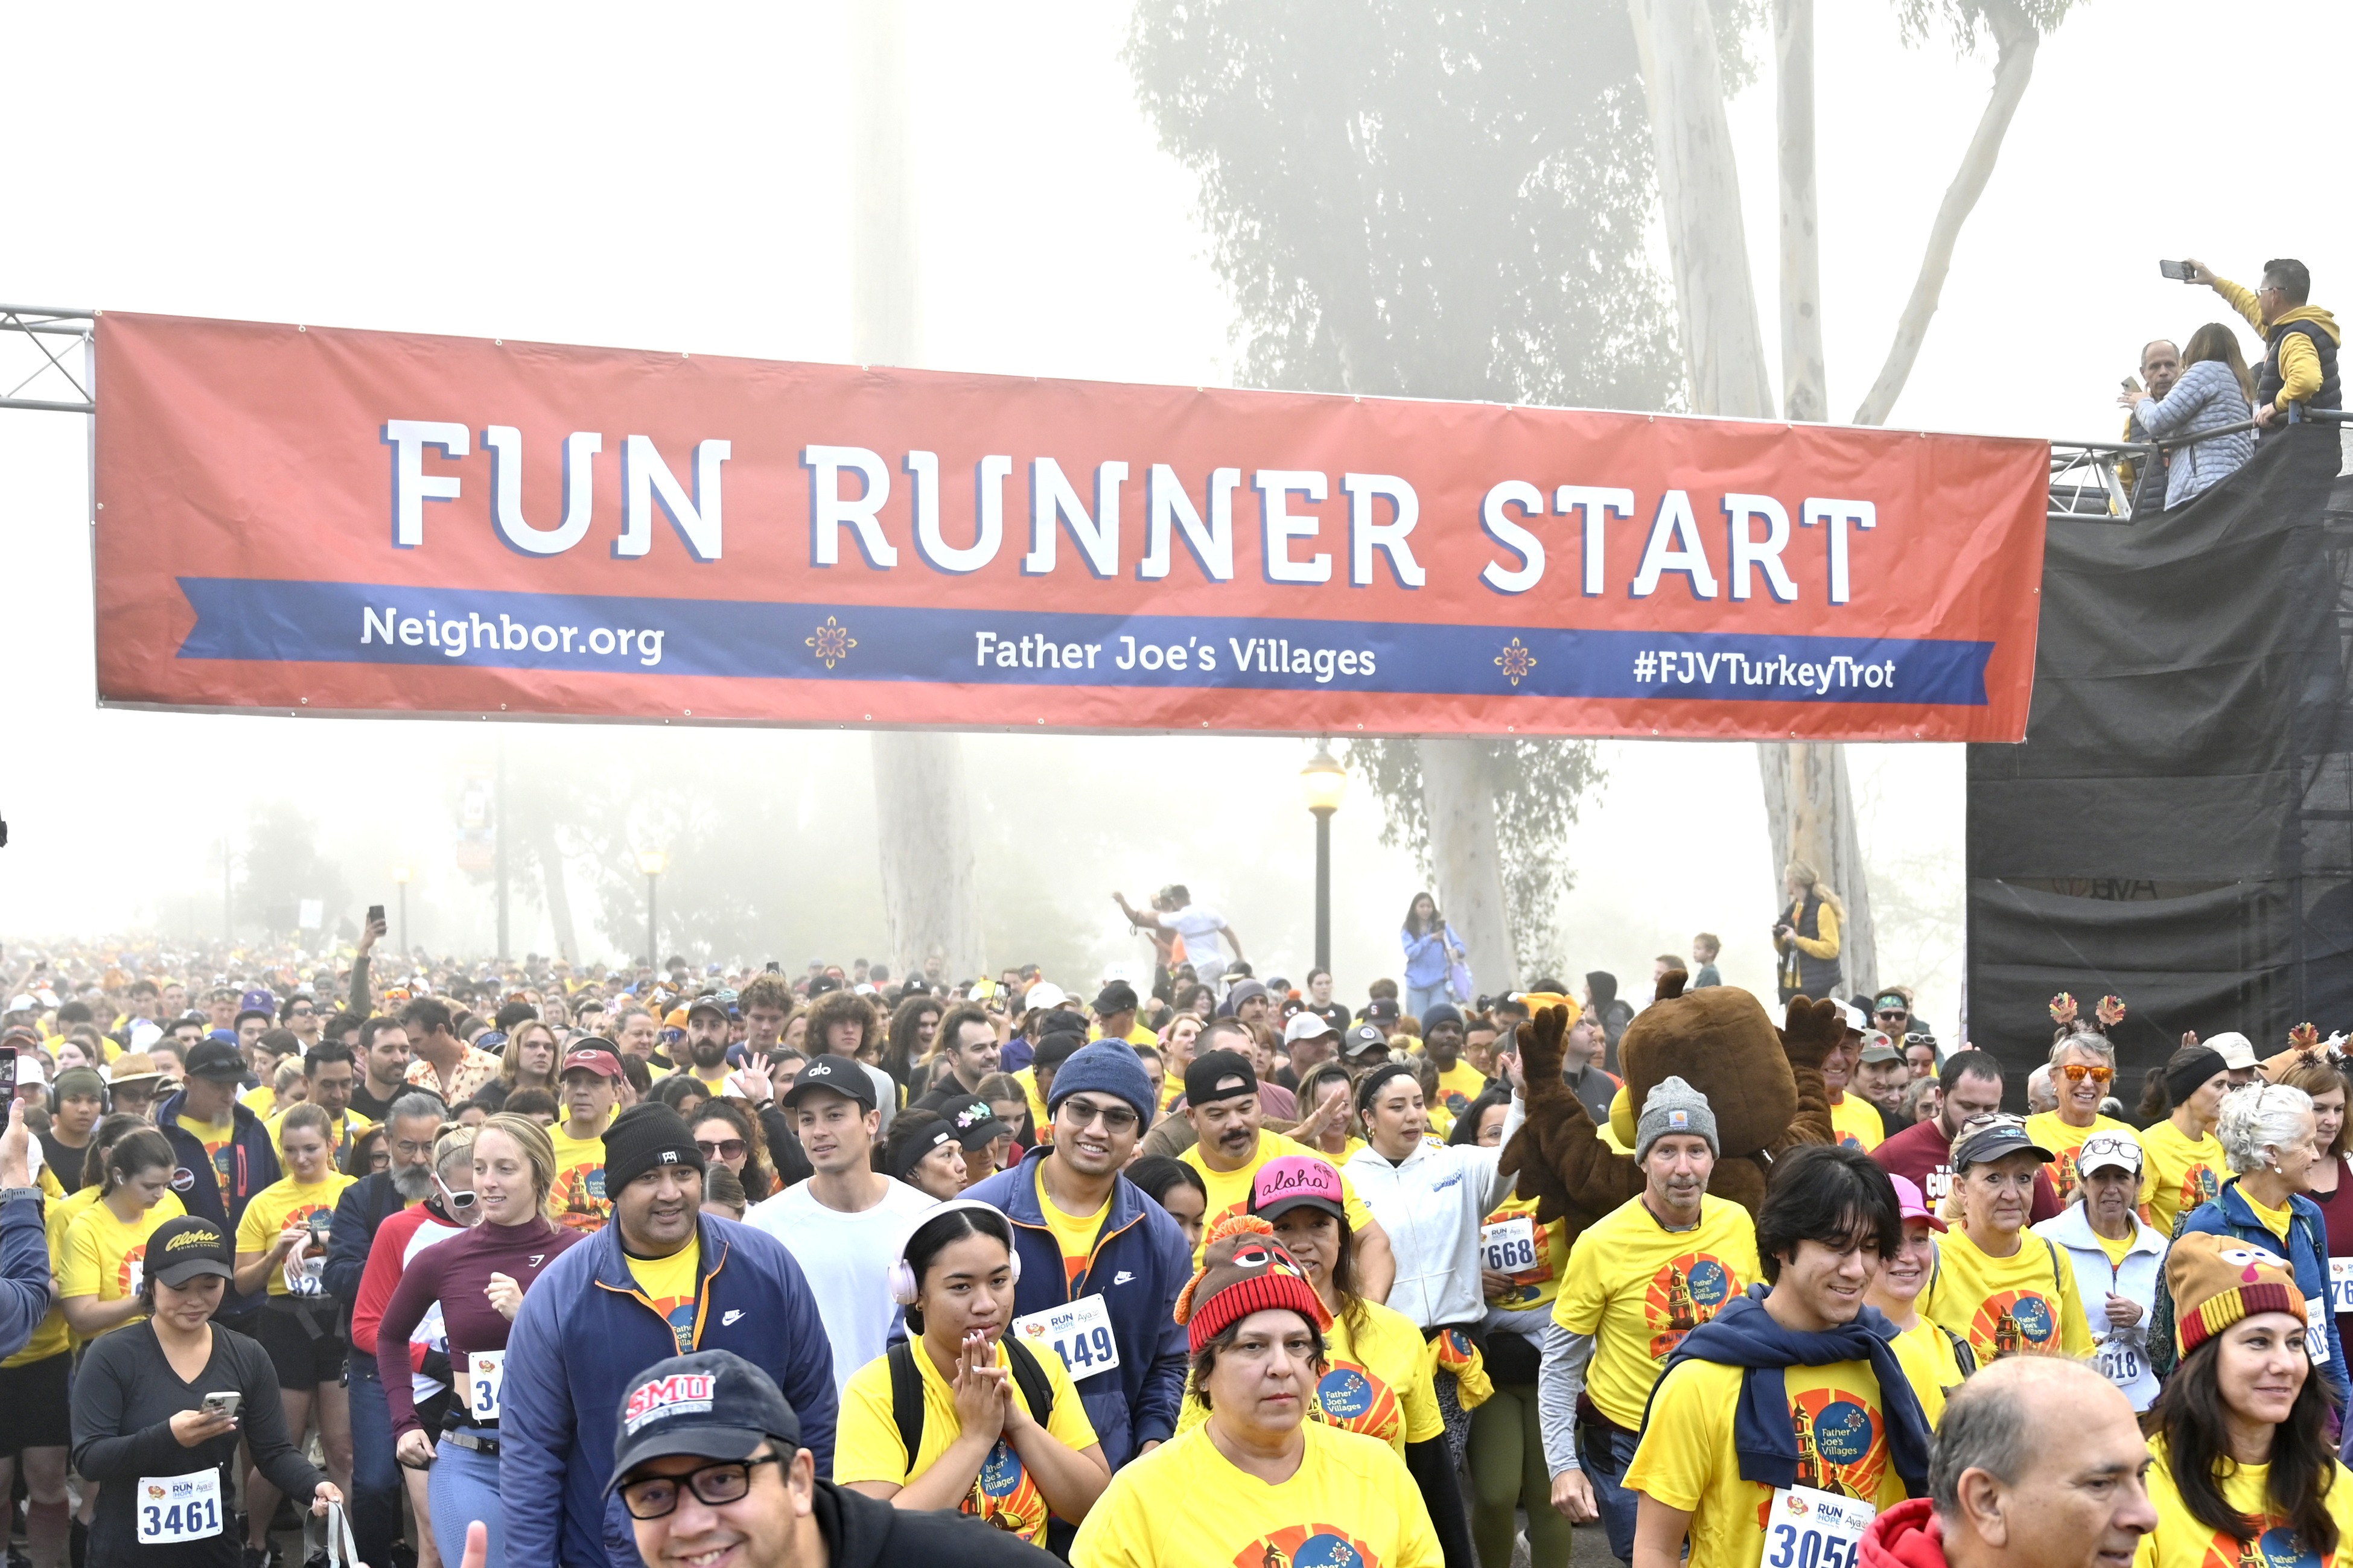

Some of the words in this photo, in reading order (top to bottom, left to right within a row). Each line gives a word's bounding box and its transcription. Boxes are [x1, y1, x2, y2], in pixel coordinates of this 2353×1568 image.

[381, 419, 731, 562] FUN
[801, 445, 1425, 588] RUNNER
[1480, 480, 1876, 604] START
[361, 606, 664, 666] Neighbor.org
[976, 632, 1101, 668] Father
[1116, 636, 1217, 671] Joe's
[1229, 637, 1377, 683] Villages
[1633, 650, 1896, 695] #FJVTurkeyTrot
[809, 1062, 832, 1077] alo
[1262, 1169, 1328, 1196] aloha
[1492, 1227, 1507, 1236] RUN
[165, 1229, 220, 1252] Aloha
[1116, 1270, 1132, 1280] NIKE
[1693, 1279, 1713, 1287] Father
[1693, 1286, 1710, 1294] Joe's
[1695, 1290, 1721, 1301] Villages
[725, 1309, 740, 1320] NIKE
[1051, 1312, 1074, 1327] RUN
[1078, 1310, 1093, 1323] Aya
[677, 1332, 692, 1340] oe's
[2025, 1328, 2047, 1336] Villages
[476, 1380, 500, 1412] 3
[626, 1375, 715, 1422] SMU
[1325, 1390, 1352, 1398] Father
[1328, 1403, 1361, 1412] Villages
[1822, 1428, 1850, 1437] Father
[1821, 1437, 1844, 1446] Joe's
[1821, 1446, 1858, 1456] Villages
[173, 1482, 193, 1493] RUN
[144, 1497, 218, 1535] 3461
[1817, 1503, 1843, 1519] RUN
[1845, 1515, 1861, 1529] Aya
[1818, 1513, 1841, 1525] HOPE
